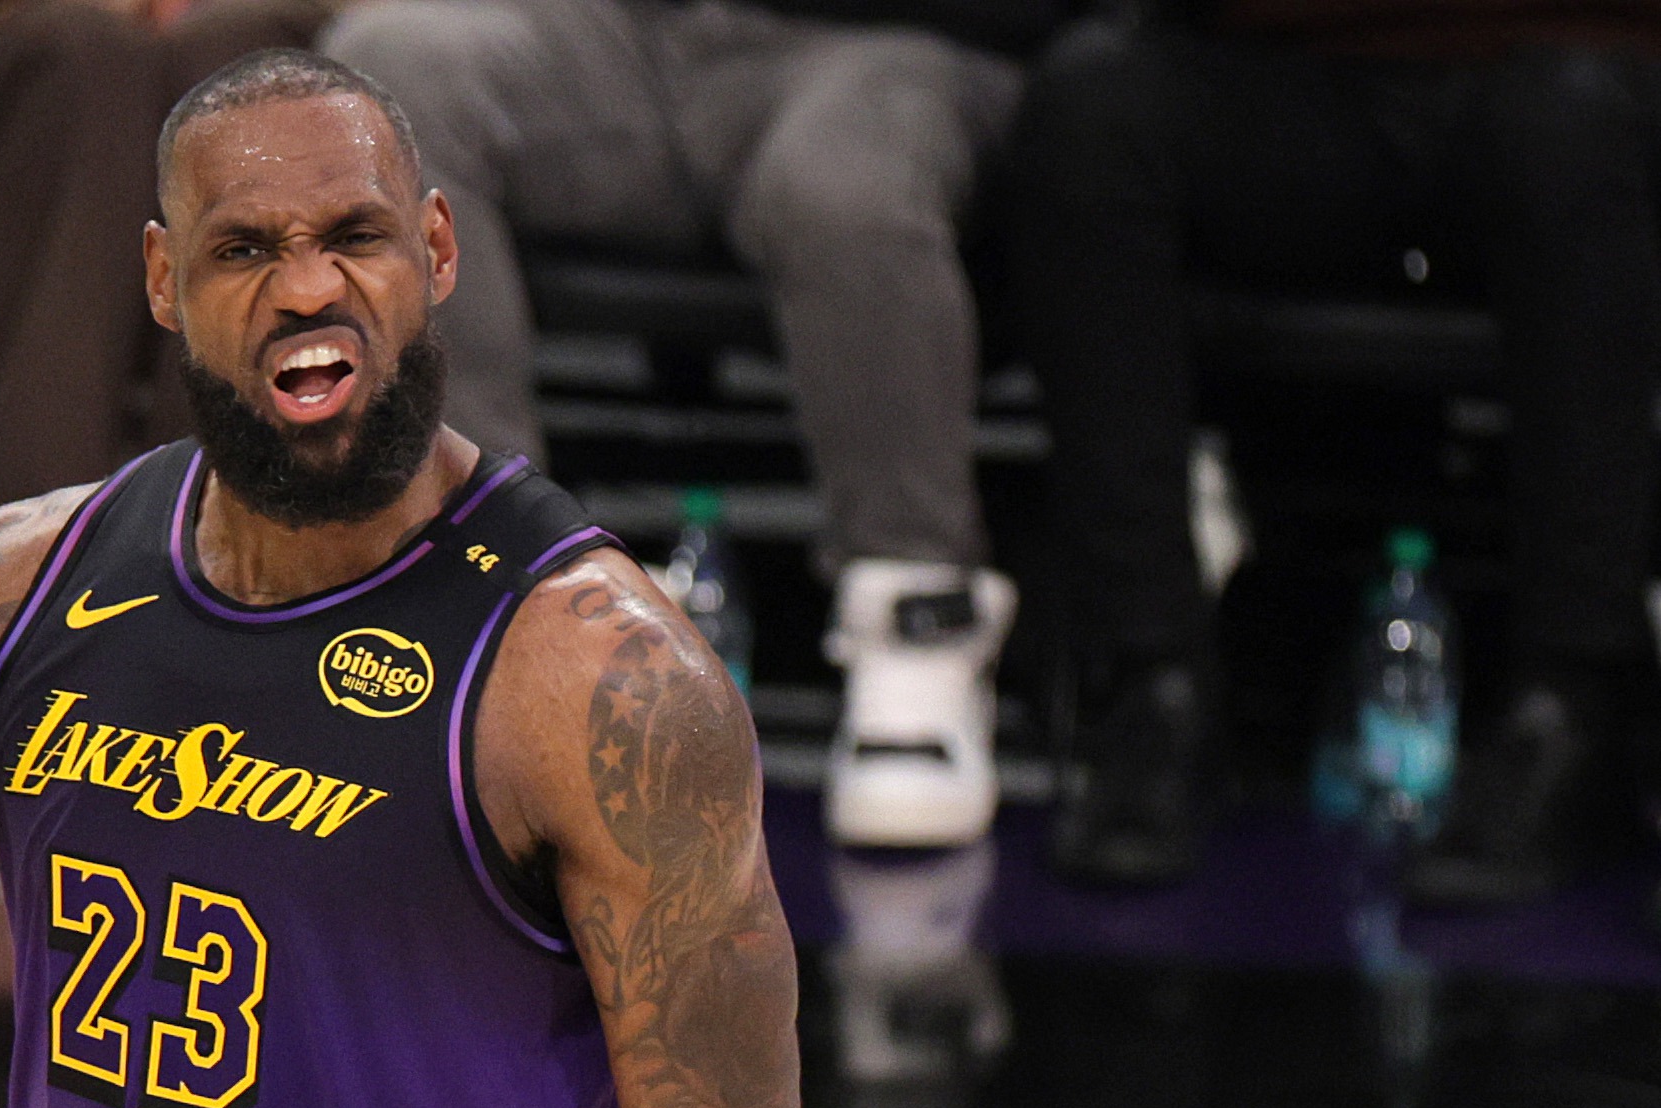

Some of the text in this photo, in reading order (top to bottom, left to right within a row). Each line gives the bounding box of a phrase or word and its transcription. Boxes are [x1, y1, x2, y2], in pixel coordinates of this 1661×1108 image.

[466, 544, 500, 573] 44
[330, 643, 426, 698] bibigo
[340, 674, 382, 698] 비비고
